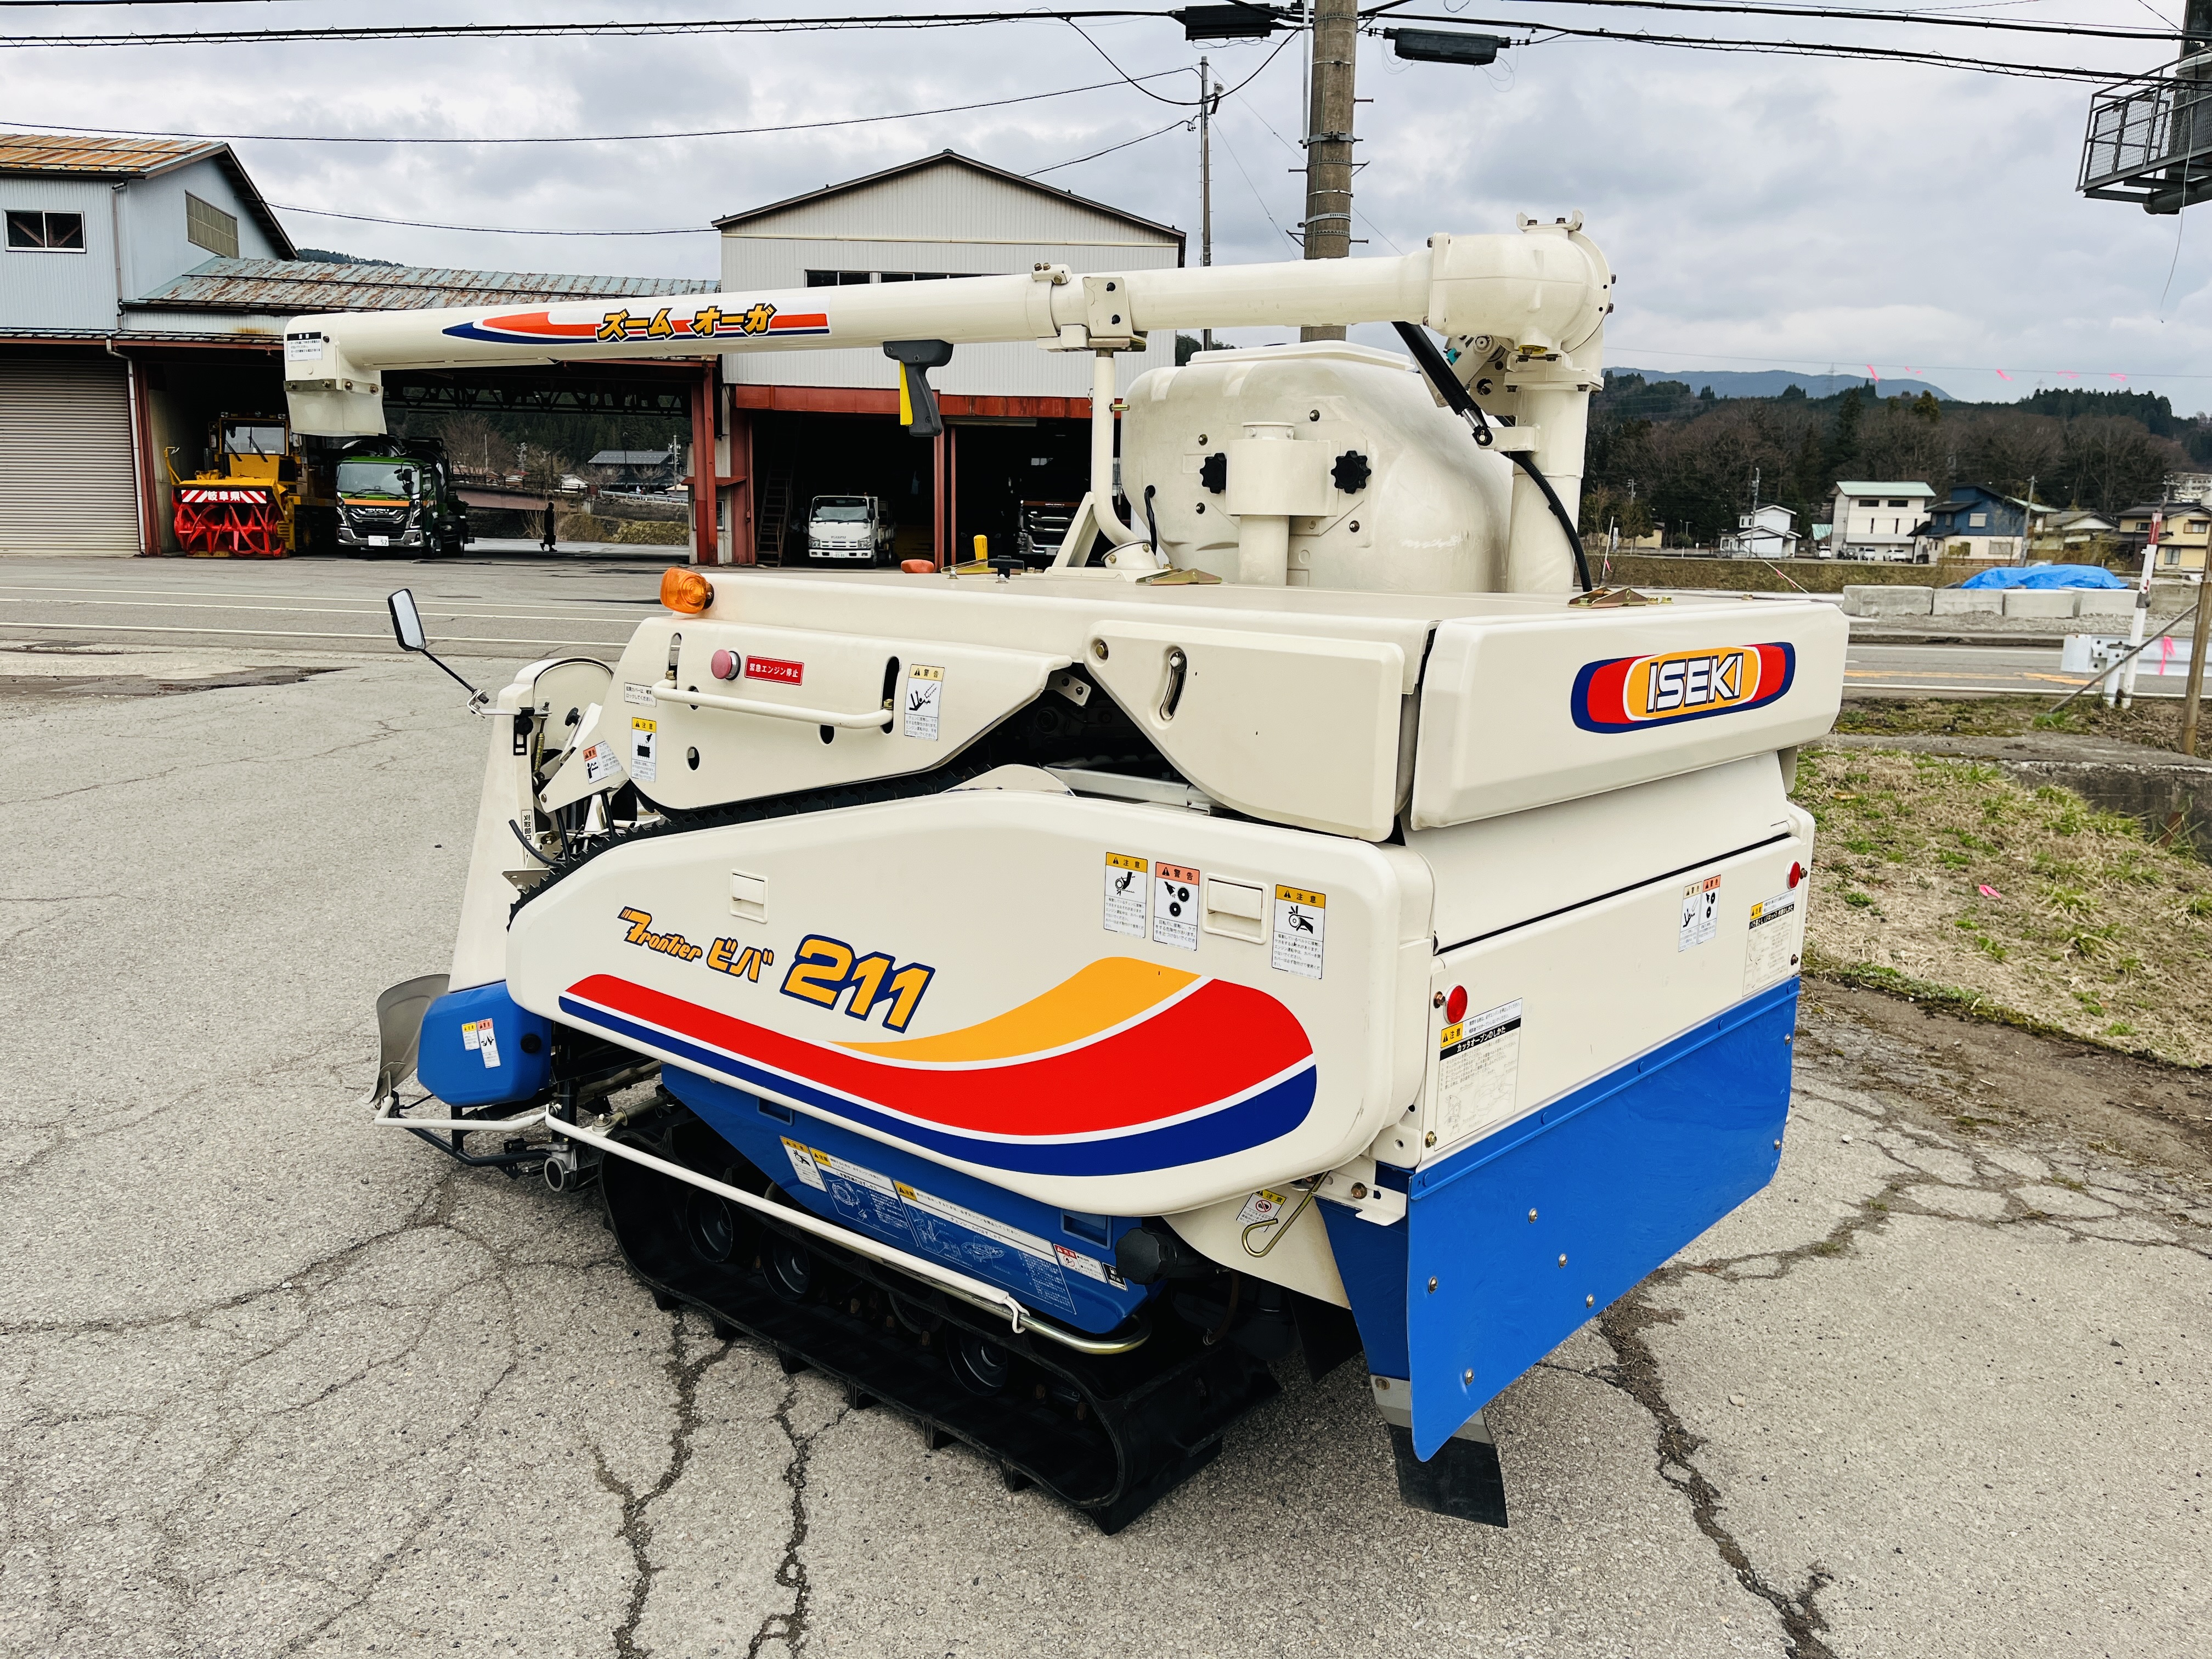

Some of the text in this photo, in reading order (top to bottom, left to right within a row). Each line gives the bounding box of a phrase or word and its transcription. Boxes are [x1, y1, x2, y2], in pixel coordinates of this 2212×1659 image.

[597, 303, 777, 340] ズーム オーガ
[207, 490, 240, 501] 岐阜県
[749, 663, 798, 678] 緊急エンジン停止
[924, 669, 939, 678] 警告
[1646, 652, 1743, 713] ISEKI
[1123, 859, 1140, 868] 注意
[1173, 868, 1193, 881] 警告
[1296, 893, 1316, 903] 注意
[617, 906, 935, 1034] Frontier ビバ 211
[1450, 1028, 1461, 1039] 注意
[1457, 1025, 1506, 1052] カッタオープンのしかた
[1266, 1193, 1283, 1203] 注意
